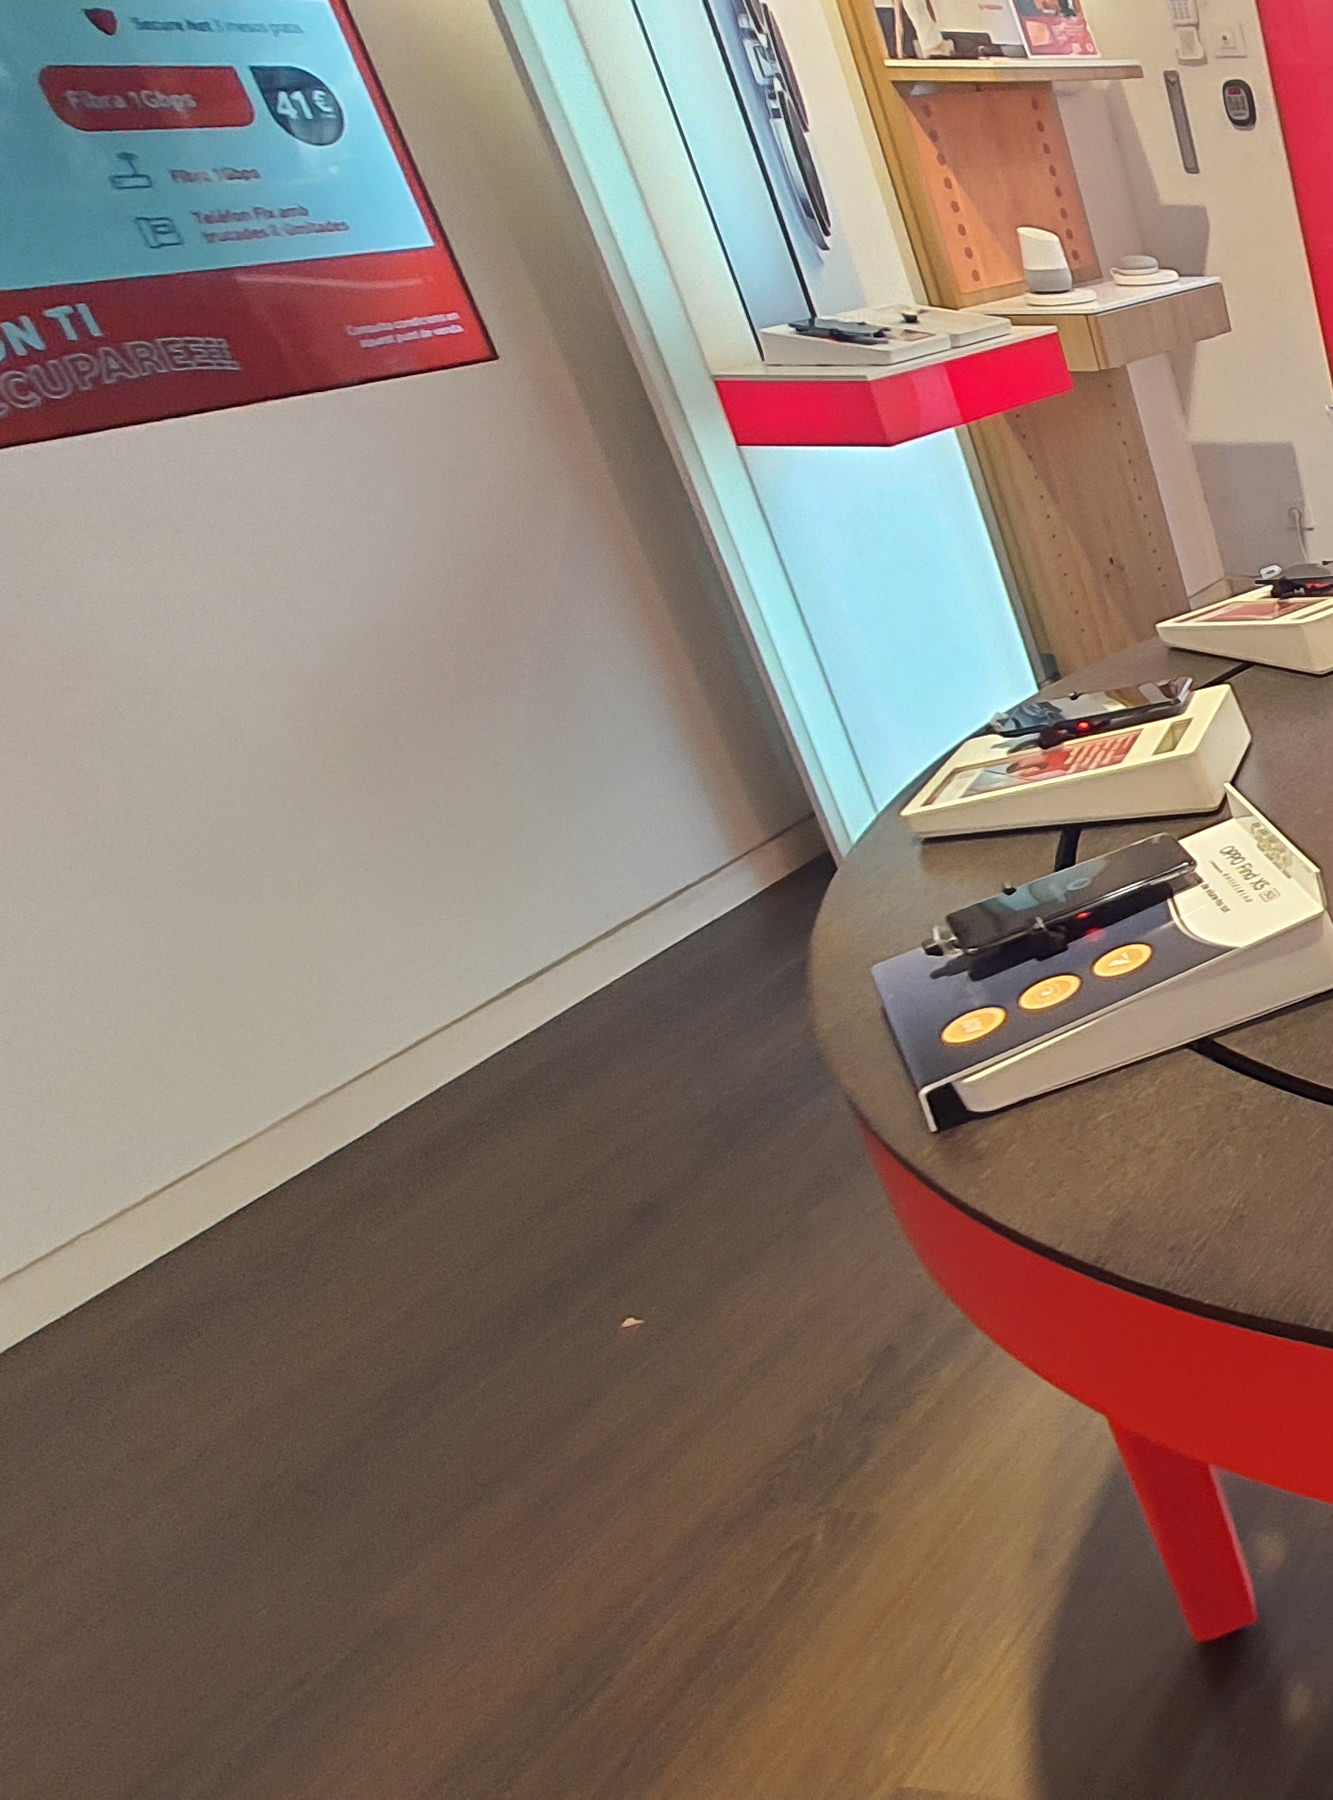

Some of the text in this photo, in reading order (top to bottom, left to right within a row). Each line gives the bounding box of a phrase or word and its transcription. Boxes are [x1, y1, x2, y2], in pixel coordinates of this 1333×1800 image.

[1219, 845, 1246, 866] OPPO
[1236, 862, 1260, 881] Find
[1250, 877, 1271, 891] X5
